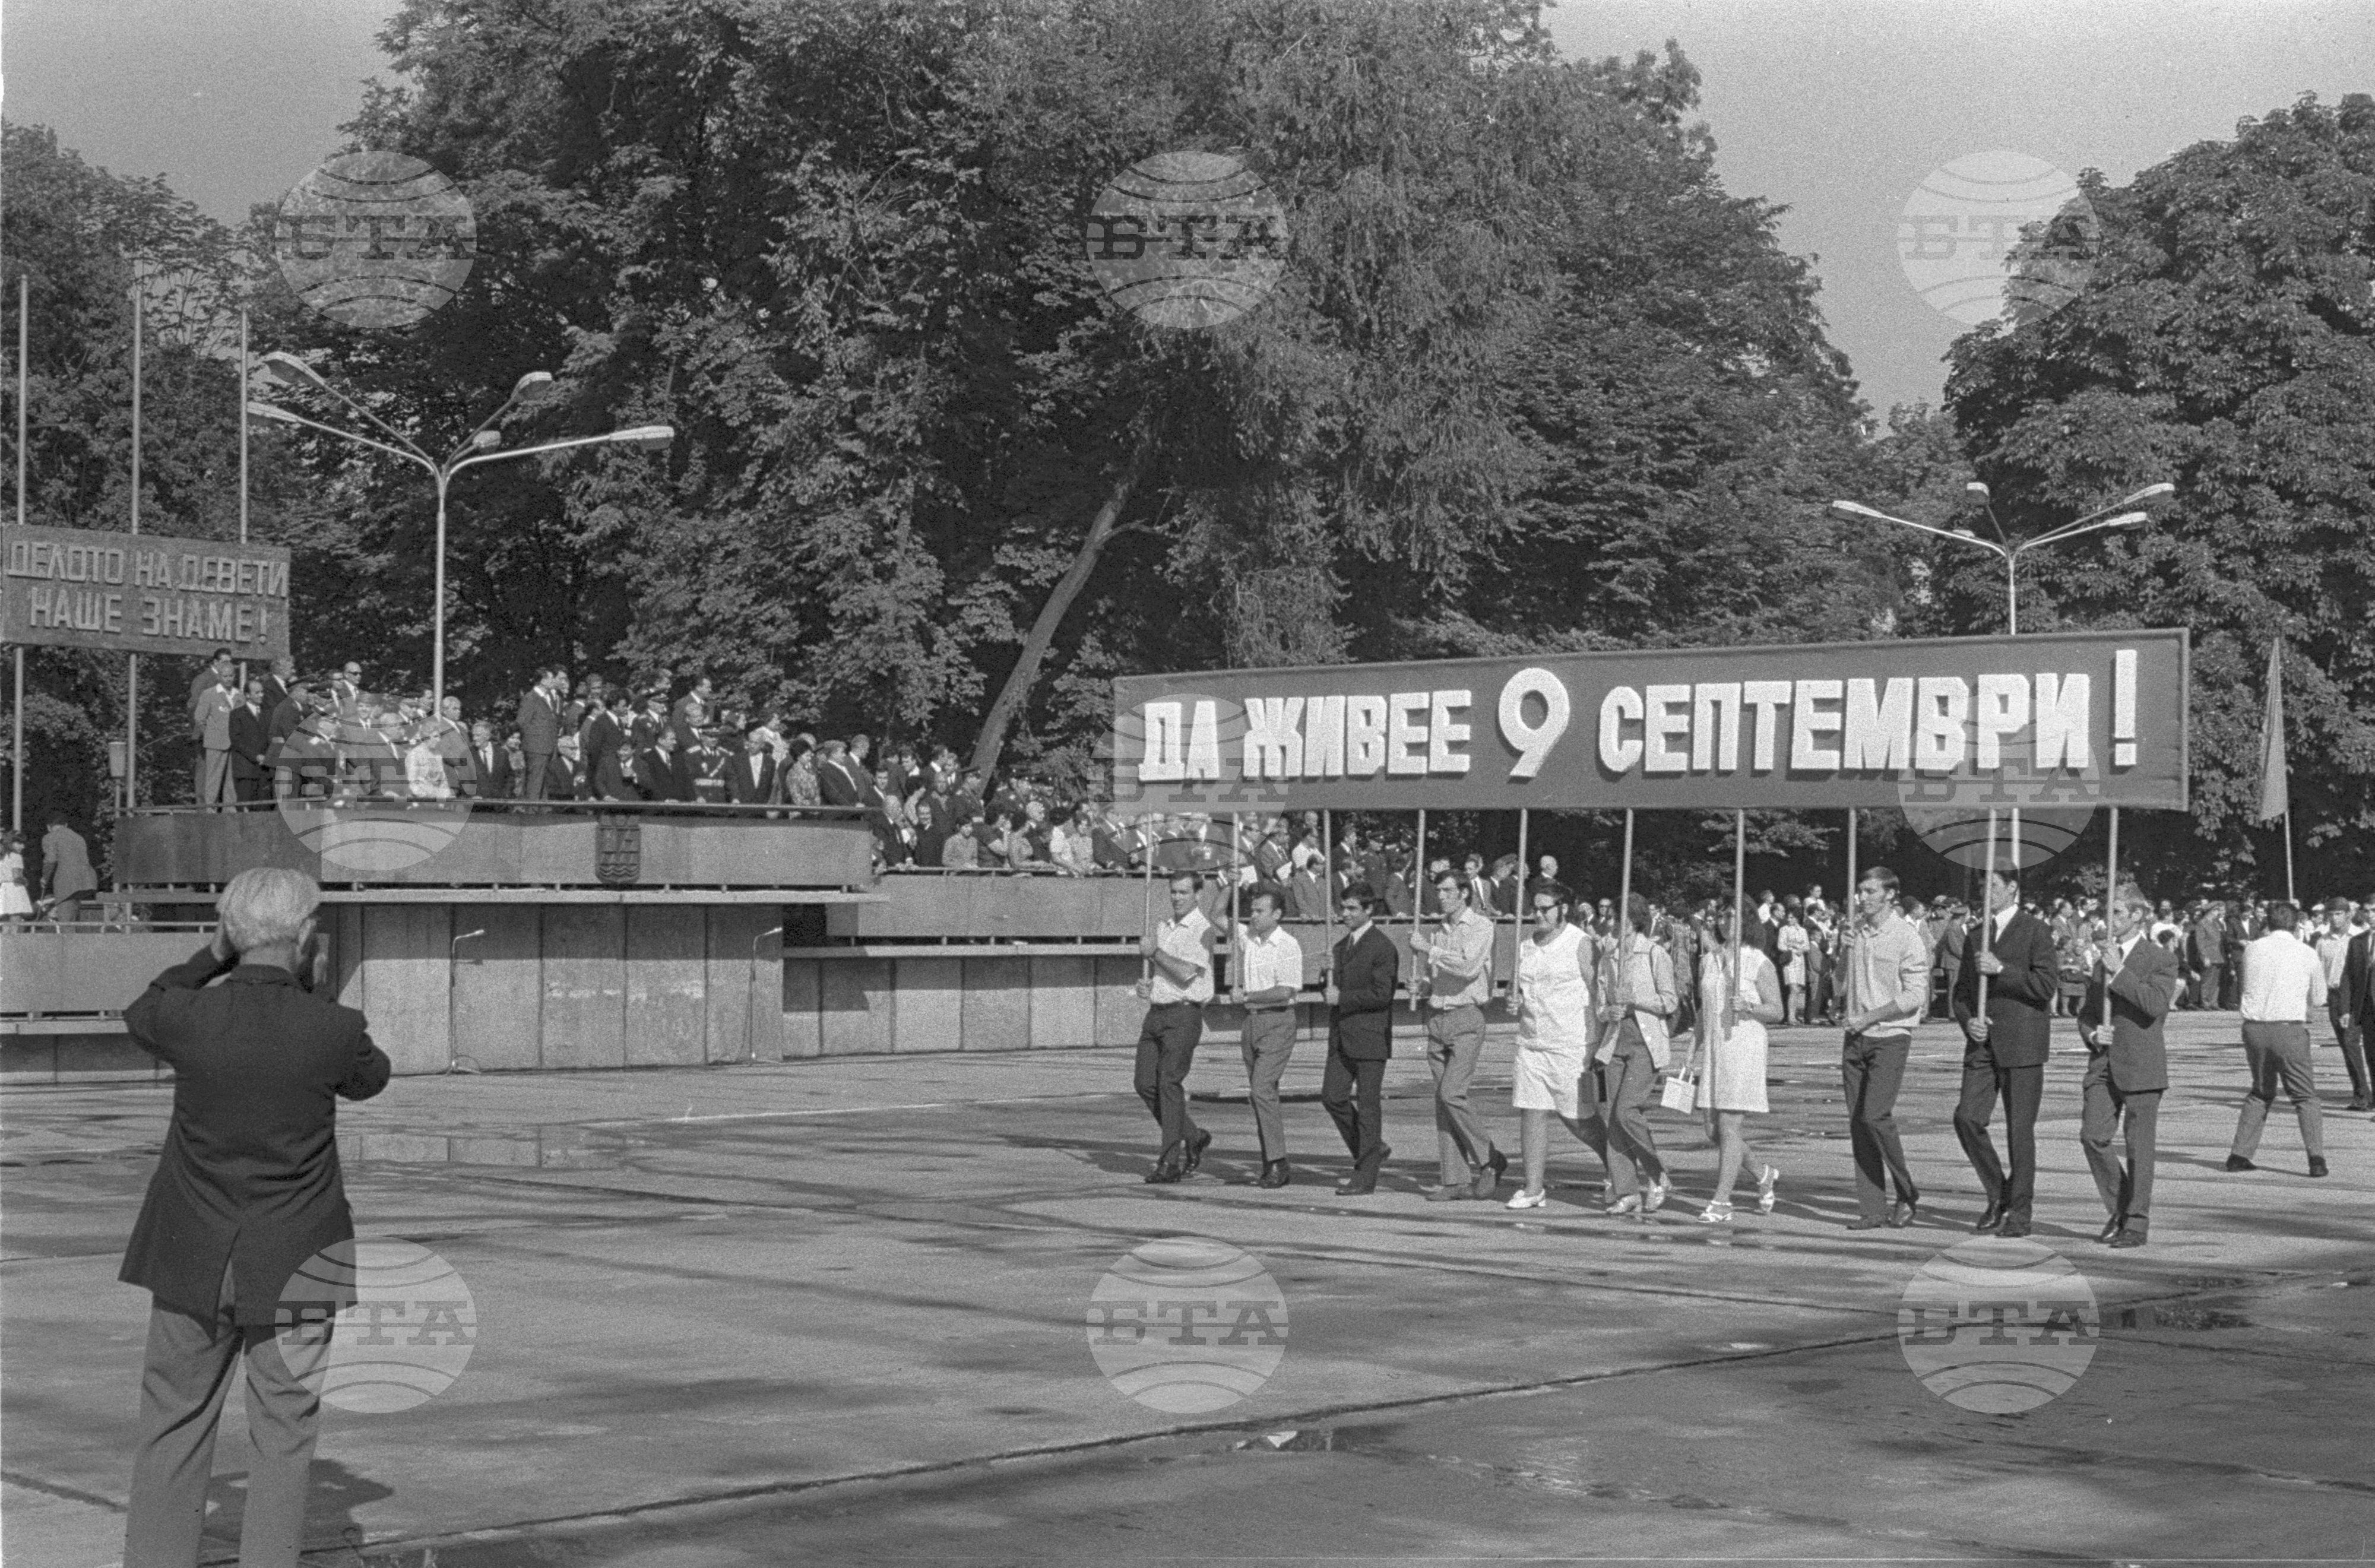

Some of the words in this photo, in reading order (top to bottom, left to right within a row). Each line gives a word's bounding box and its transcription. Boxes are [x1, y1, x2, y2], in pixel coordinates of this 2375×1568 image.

[7, 540, 124, 584] ДЕЛОТО
[134, 549, 172, 590] НА
[178, 553, 289, 598] ДЕВЕТИ
[30, 587, 122, 634] НАШЕ
[1138, 701, 1220, 781] ДА
[1243, 689, 1472, 777] ЖИВЕЕ
[1498, 667, 1570, 778] 9
